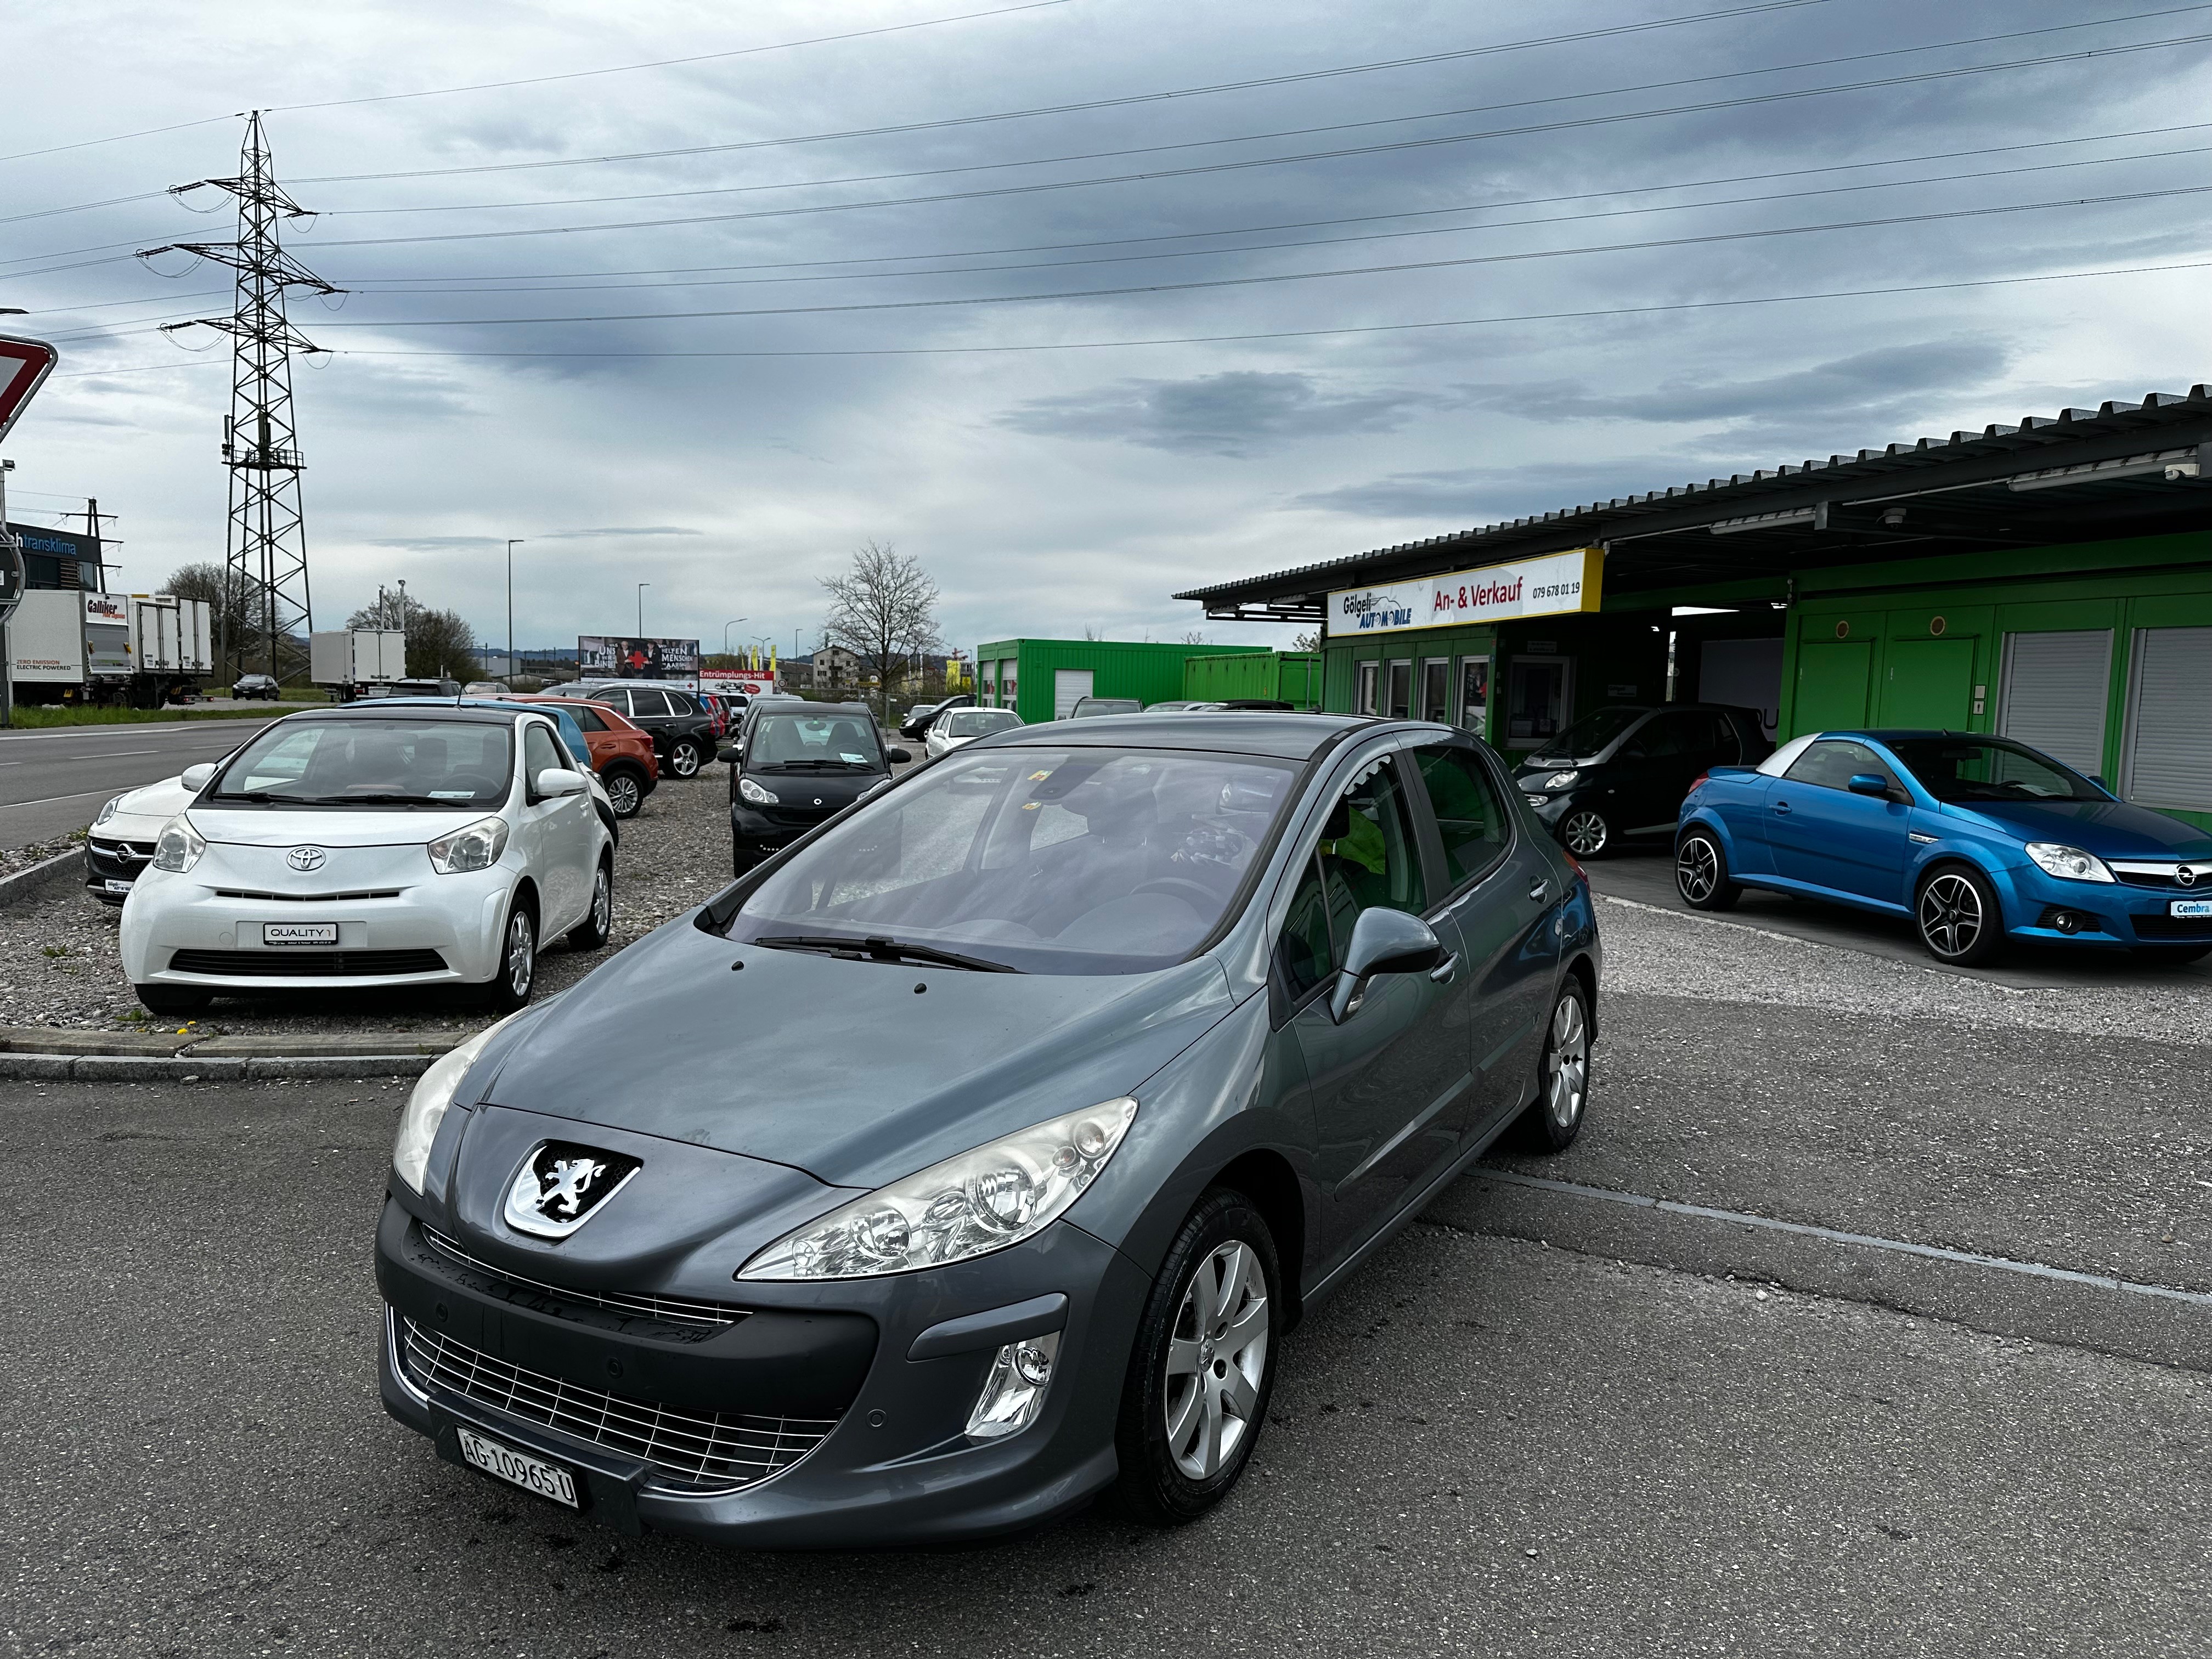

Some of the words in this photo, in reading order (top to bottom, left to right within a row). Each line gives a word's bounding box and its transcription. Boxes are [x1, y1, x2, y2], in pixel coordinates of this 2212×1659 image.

[1434, 590, 1454, 612] An-
[1458, 586, 1468, 609] &
[1471, 576, 1523, 607] Verkauf
[1533, 587, 1545, 599] 079
[1547, 585, 1559, 597] 678
[1561, 583, 1569, 595] 01
[1571, 582, 1580, 594] 19
[87, 599, 117, 614] Galliker
[1344, 592, 1372, 618] Gölgeli
[1359, 608, 1412, 629] AUTOMOBILE
[599, 646, 616, 655] UNS
[661, 644, 687, 655] HELFEN
[661, 653, 693, 662] MENSCHEN
[699, 670, 765, 680] Entrümplungs-Hit
[2177, 903, 2210, 913] Cembra
